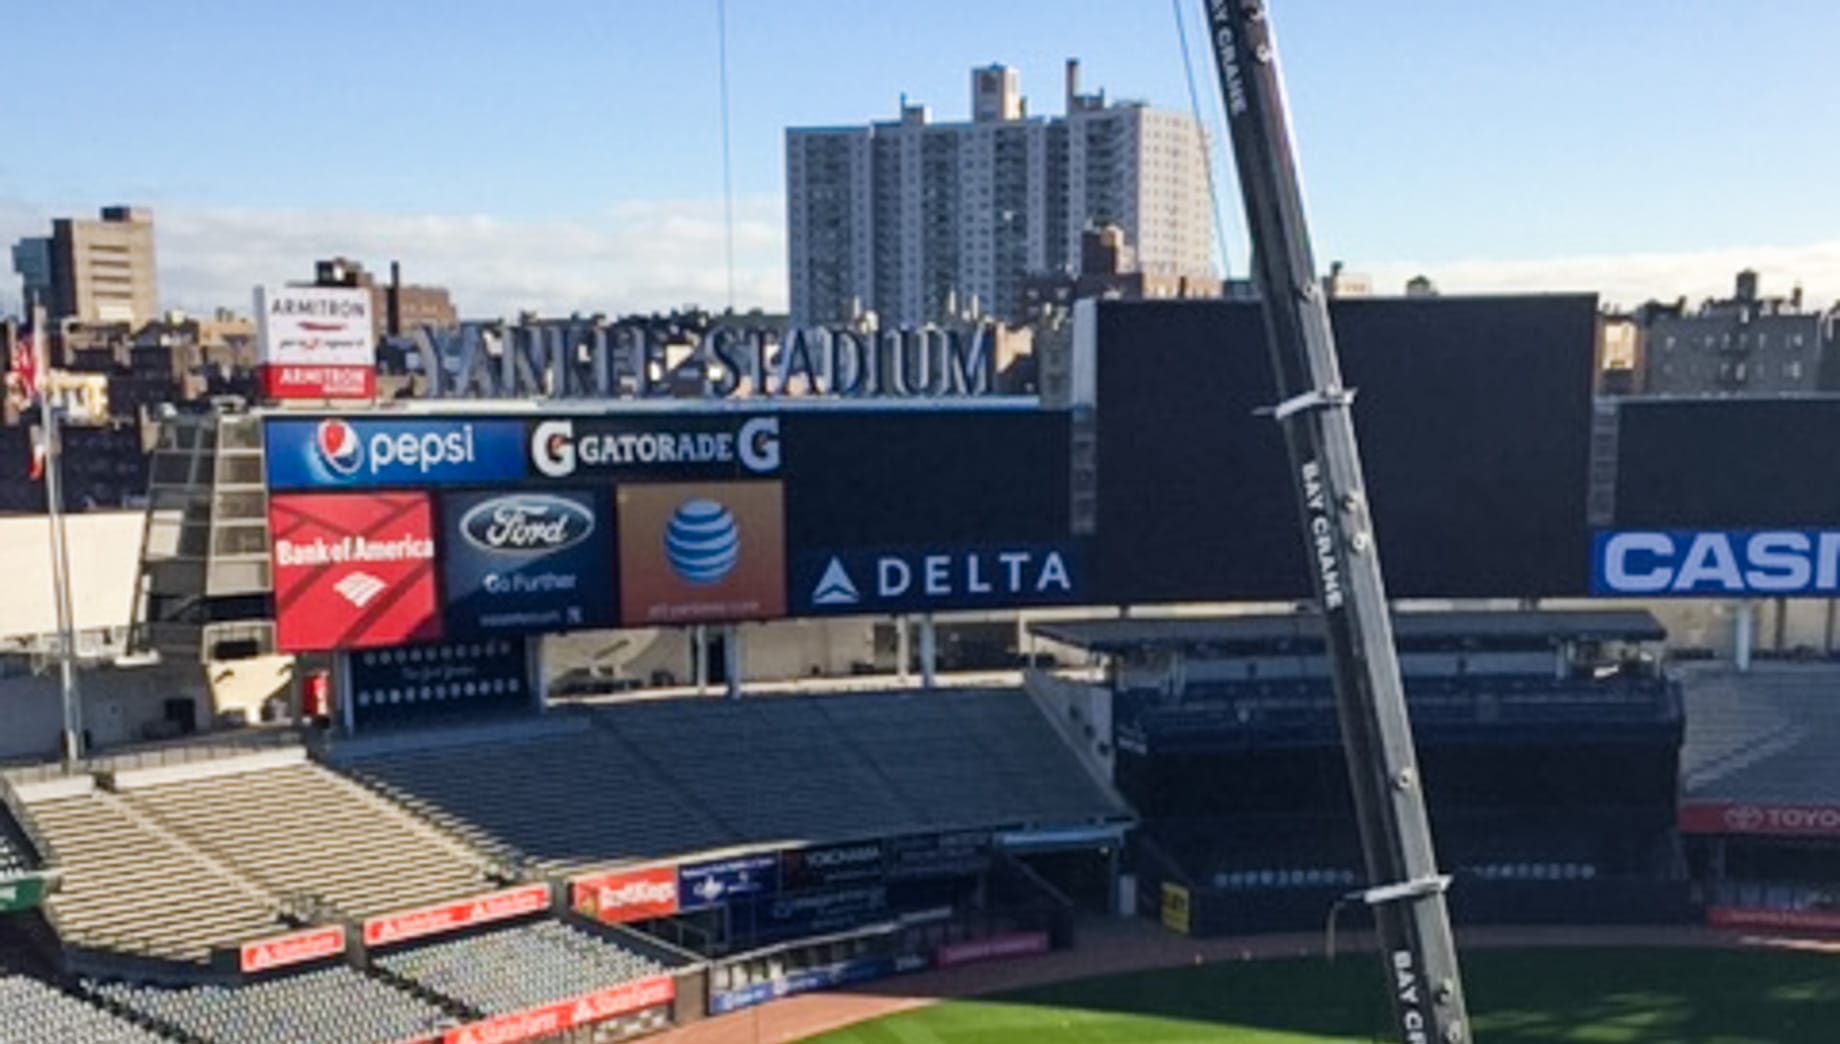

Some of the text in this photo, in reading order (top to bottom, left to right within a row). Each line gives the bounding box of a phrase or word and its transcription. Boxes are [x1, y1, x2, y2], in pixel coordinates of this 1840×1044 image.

[1217, 26, 1247, 117] CRANE
[271, 298, 365, 319] ARMITRON
[413, 322, 992, 398] YANKEE STADIUM
[369, 423, 475, 475] pepsi
[578, 433, 733, 465] GATORADE
[485, 503, 569, 546] Ford
[1302, 461, 1344, 611] BAY CRANE
[275, 533, 434, 566] Bank of America
[483, 572, 577, 594] Go Further
[877, 551, 1071, 597] DELTA
[1393, 951, 1419, 1003] BAY
